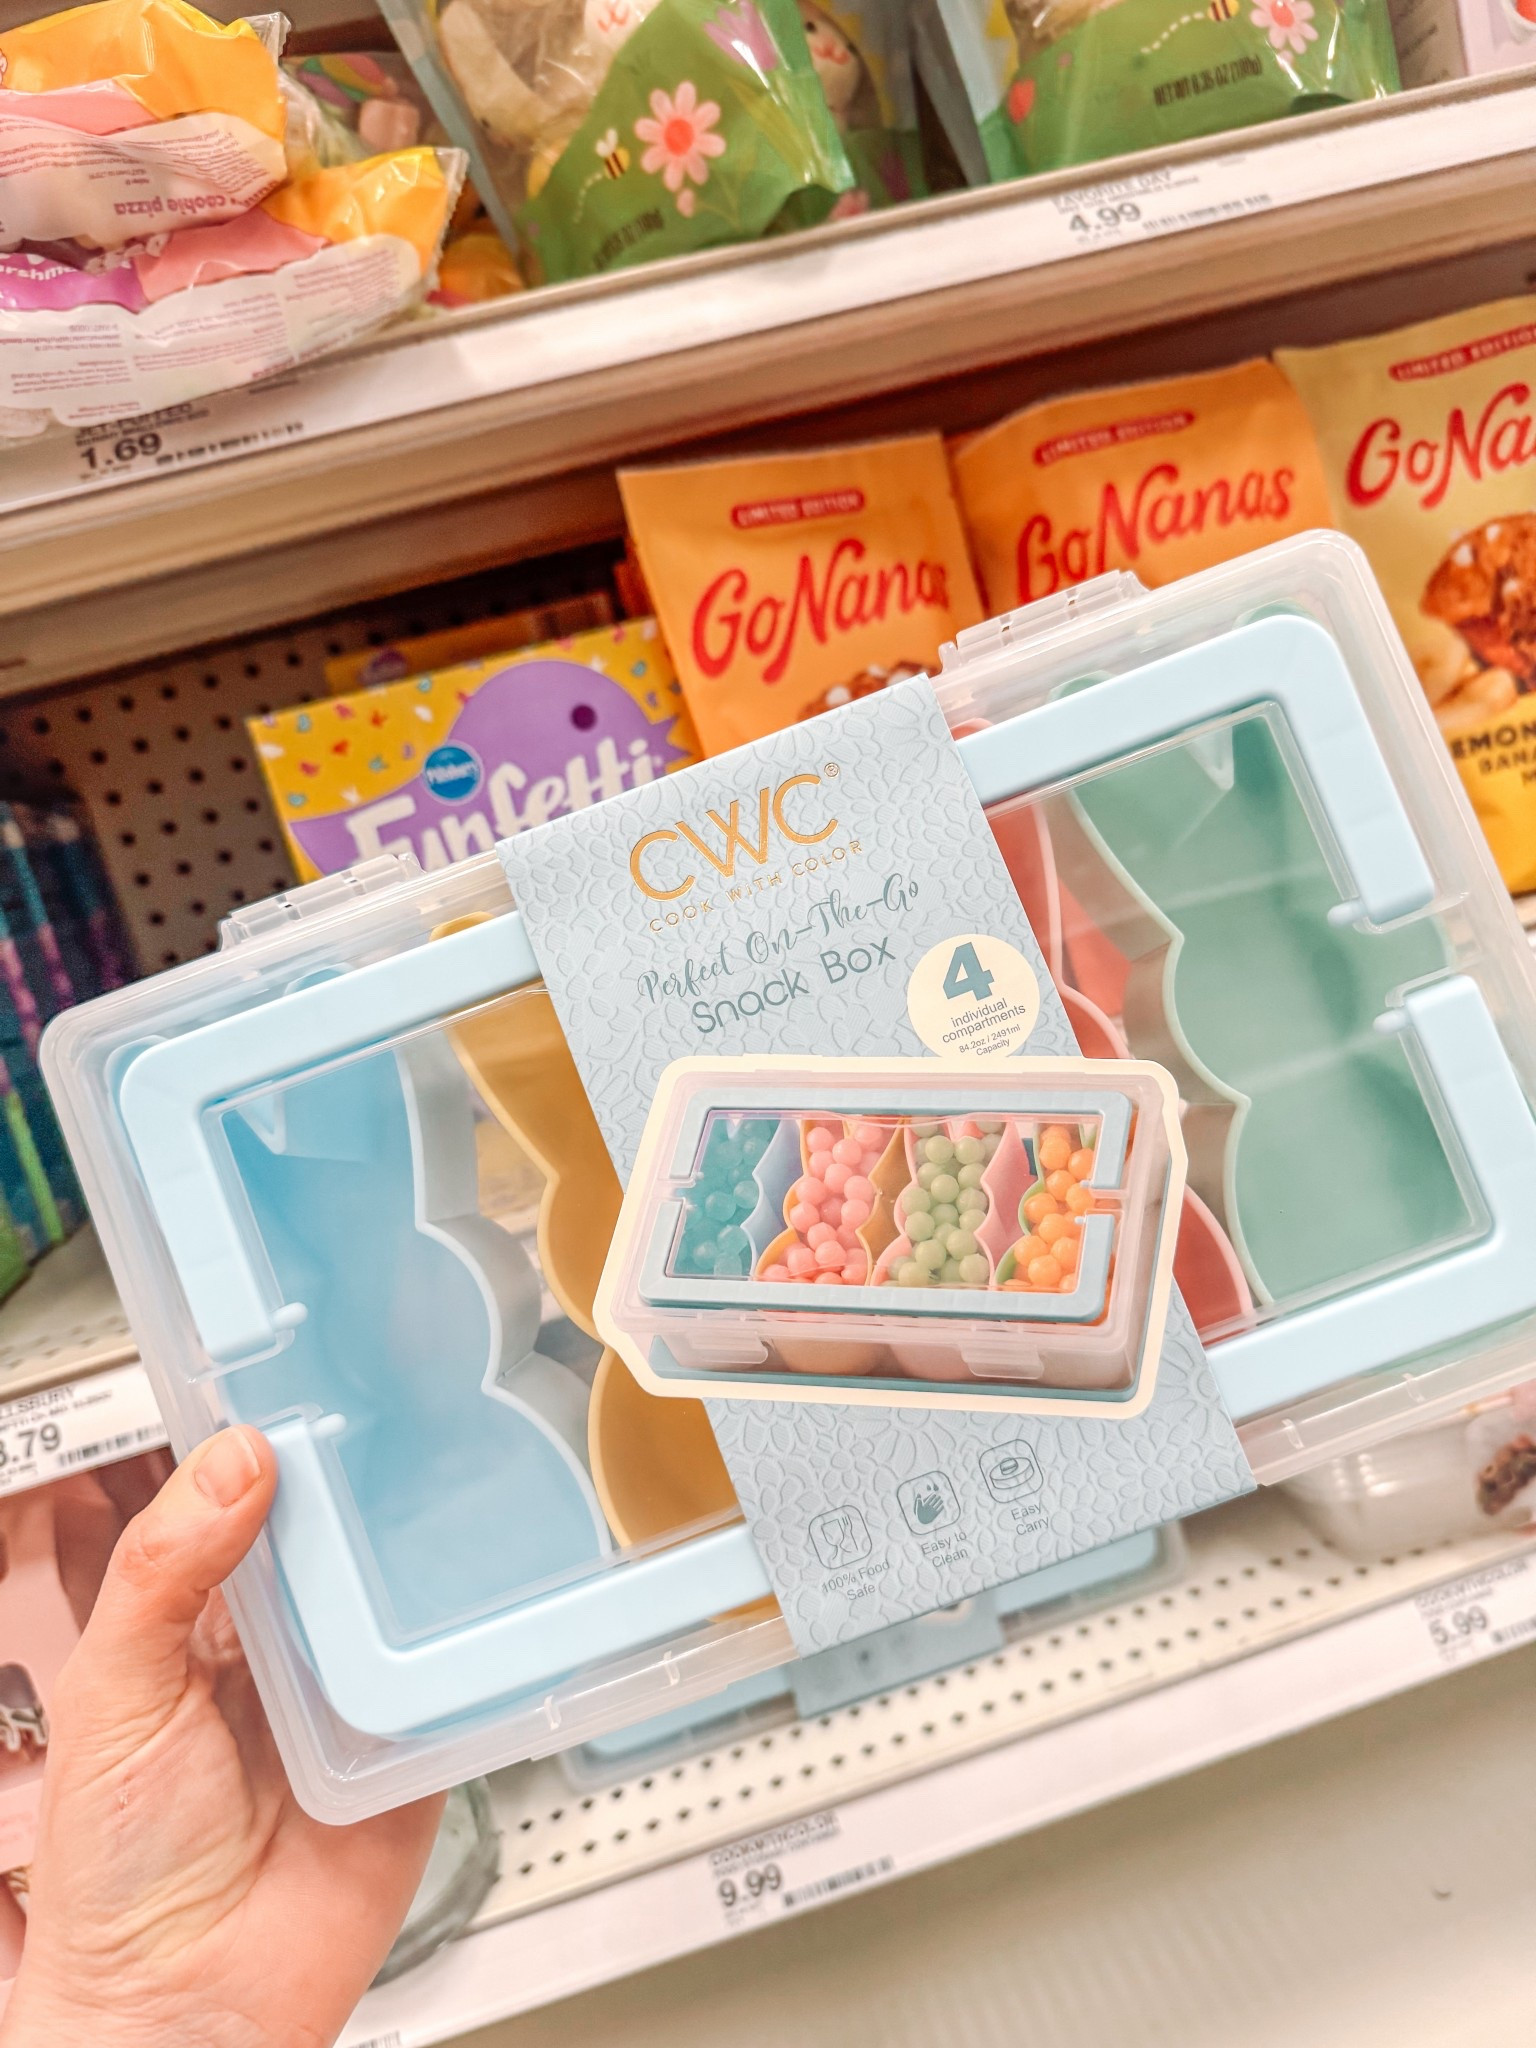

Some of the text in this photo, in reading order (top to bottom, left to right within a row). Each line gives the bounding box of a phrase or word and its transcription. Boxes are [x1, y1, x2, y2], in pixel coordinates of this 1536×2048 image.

[114, 195, 161, 218] pizza
[1069, 202, 1141, 232] 4.99
[1397, 328, 1536, 376] LIMITED EDITIO
[81, 432, 162, 469] 1.69
[1041, 413, 1188, 462] LIMITED EDITION
[737, 493, 858, 526] LIMITED EDITION
[1016, 463, 1295, 604] GoNanas
[347, 737, 658, 868] Funfetti
[649, 840, 864, 933] COOK WITH COLOR
[637, 873, 919, 1004] Perfect On-The-Go
[692, 937, 896, 1034] Snack Box
[943, 941, 994, 1001] 4
[942, 1004, 1026, 1043] compartments
[951, 998, 1008, 1028] individual
[959, 1037, 986, 1053] 84.2oz
[991, 1024, 1021, 1041] 2491ml
[976, 1038, 1010, 1056] Capacity
[1011, 1502, 1043, 1521] Easy
[1015, 1517, 1050, 1536] Carry
[921, 1531, 967, 1555] Easy to
[932, 1548, 969, 1569] Clean
[821, 1559, 891, 1593] 100% Food
[846, 1583, 876, 1601] Safe
[1428, 1605, 1488, 1645] 5.99
[718, 1863, 782, 1907] 9.99
